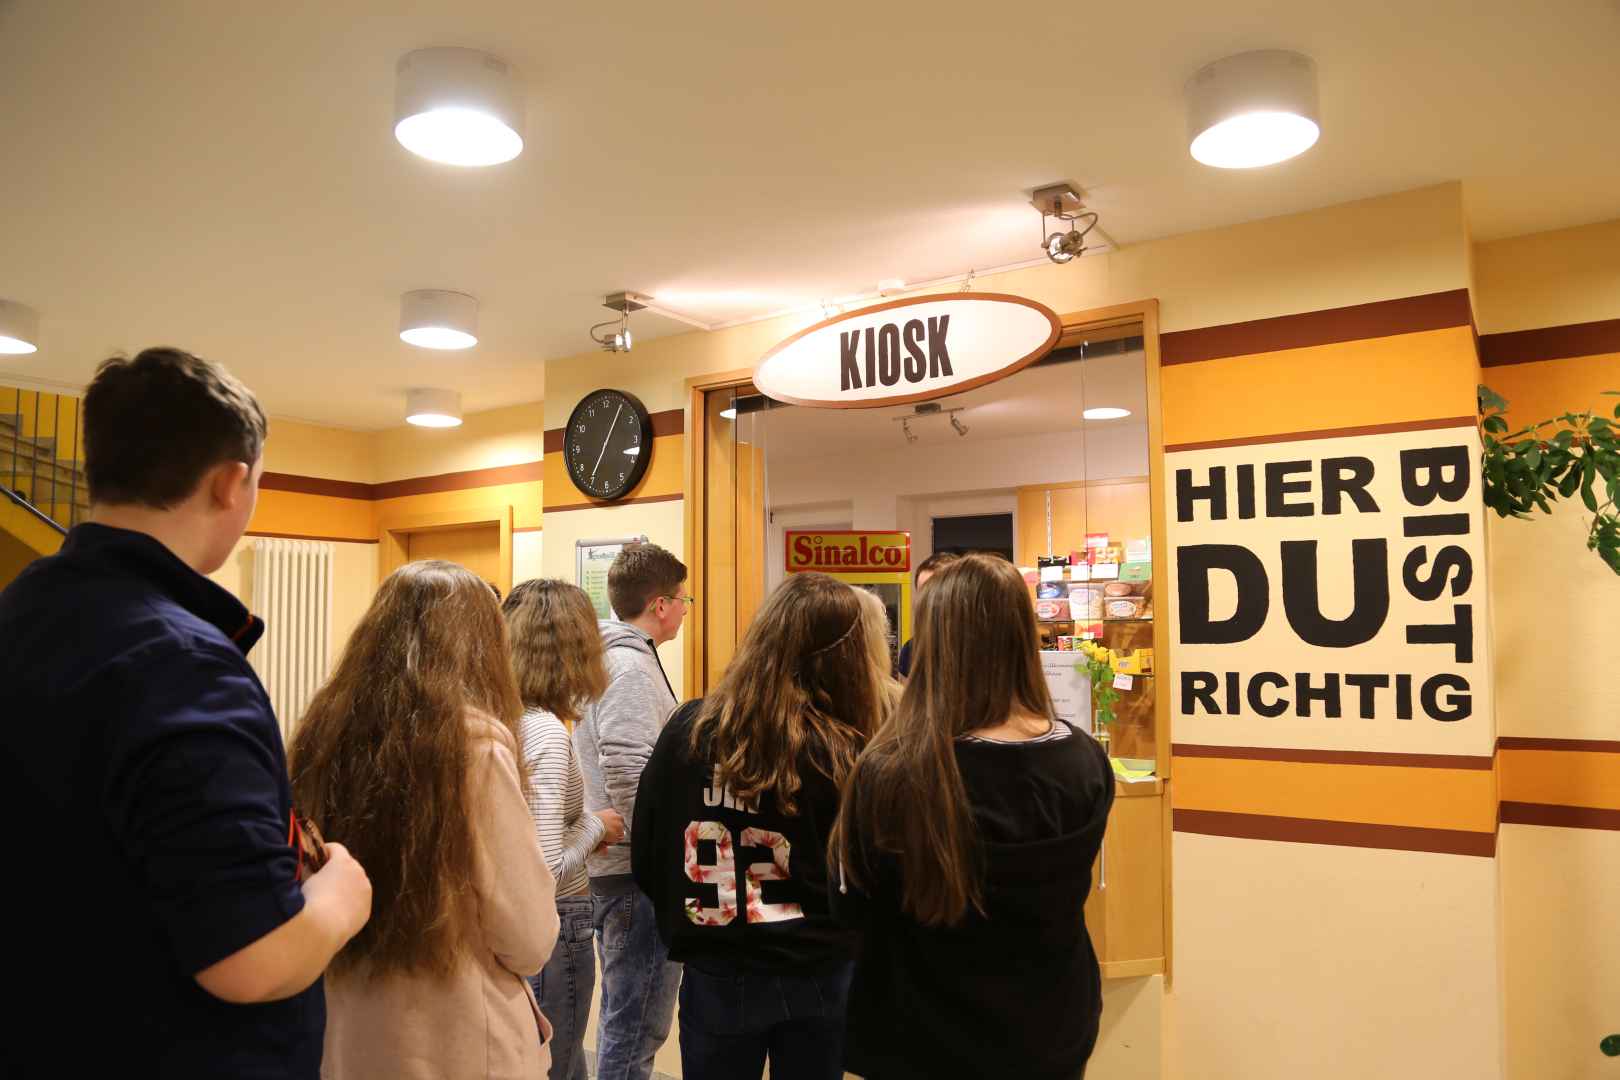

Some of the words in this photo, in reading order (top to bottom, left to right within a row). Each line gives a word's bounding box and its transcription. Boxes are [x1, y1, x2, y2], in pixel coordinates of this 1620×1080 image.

[840, 314, 954, 391] KIOSK
[578, 424, 586, 433] 10
[588, 408, 595, 417] 11
[602, 399, 610, 409] 12
[1176, 455, 1381, 523] HIER
[794, 535, 903, 566] Sinalco
[1399, 445, 1473, 664] BIST
[1176, 537, 1390, 648] DU
[1180, 671, 1473, 722] RICHTIG
[684, 820, 805, 926] 92
